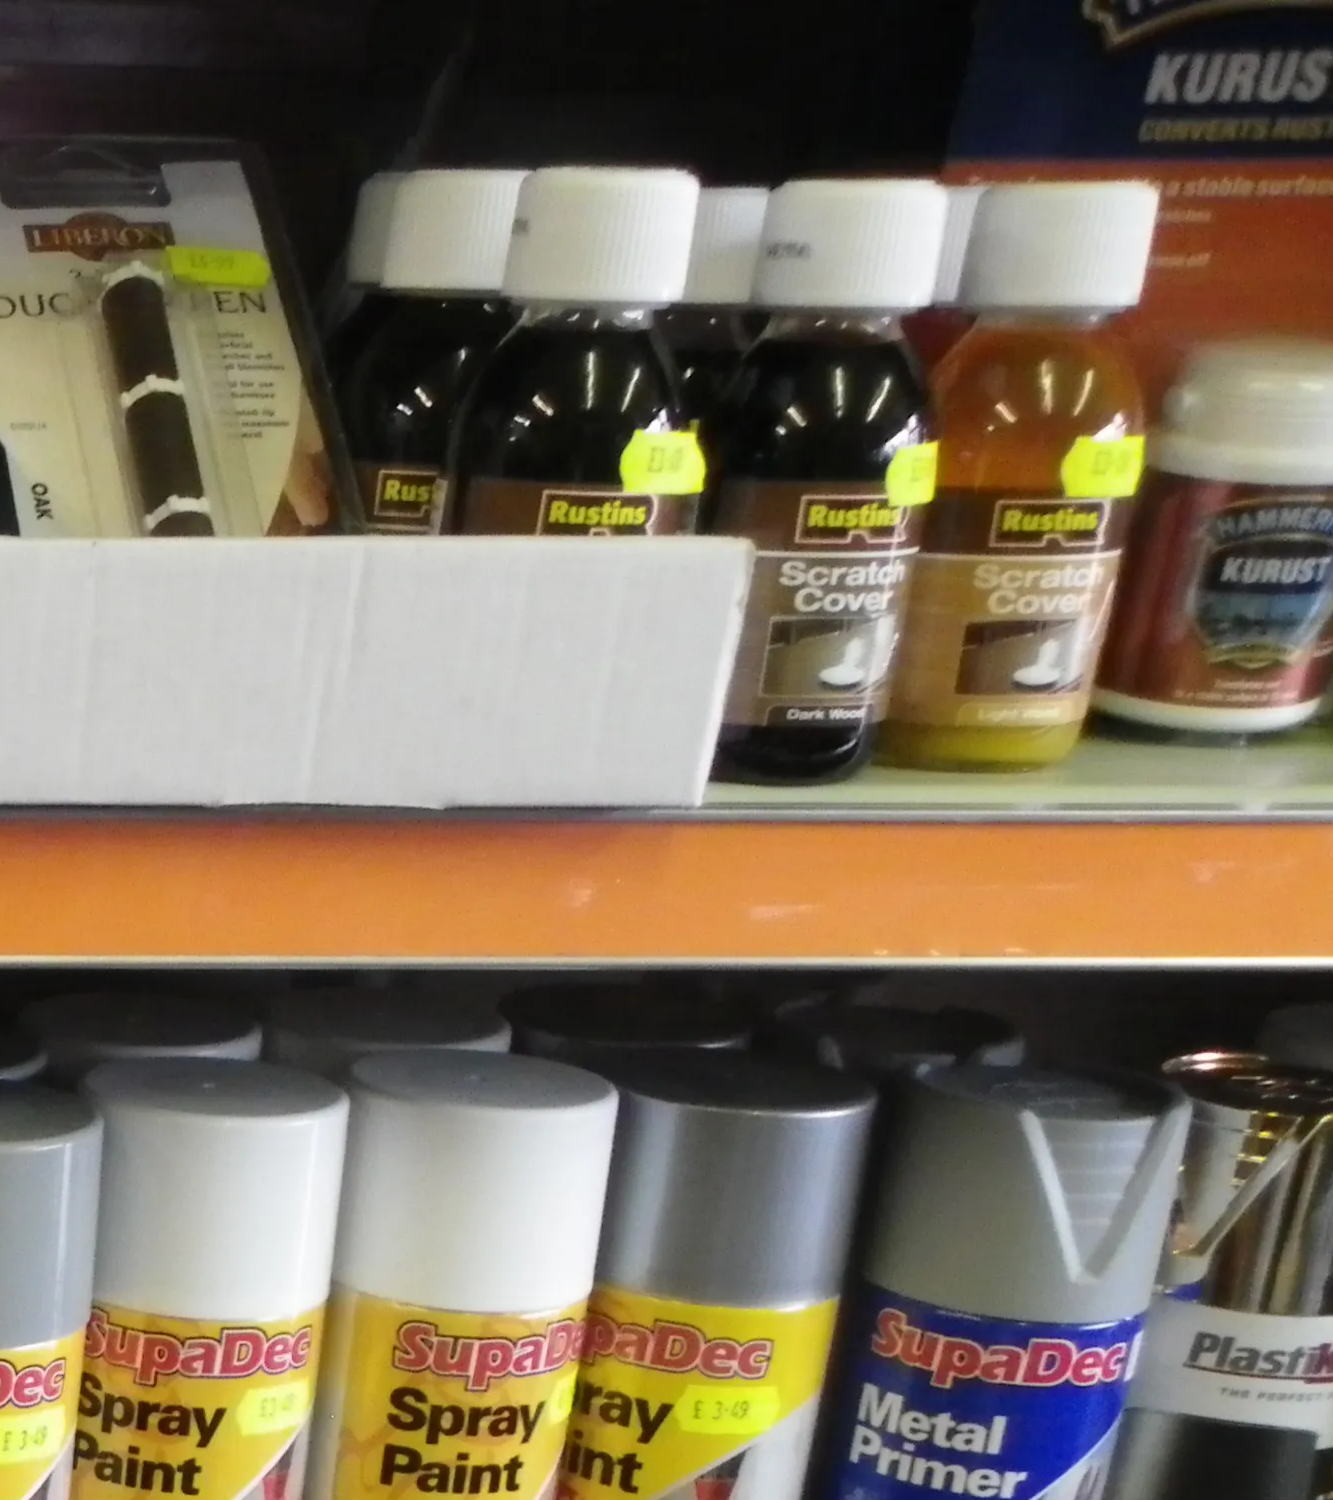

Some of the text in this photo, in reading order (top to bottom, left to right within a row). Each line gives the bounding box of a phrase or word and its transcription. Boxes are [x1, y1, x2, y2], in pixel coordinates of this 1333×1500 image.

[31, 227, 167, 248] LIBERON
[548, 499, 647, 526] Rustins
[808, 502, 902, 528] Rustins
[1002, 508, 1098, 532] Rustins
[778, 557, 906, 588] Scratch
[973, 563, 1104, 590] Scratch
[1221, 556, 1331, 584] KURUST
[794, 588, 894, 613] Cover
[987, 590, 1092, 615] Cover
[871, 1307, 1127, 1389] SupaDec
[78, 1370, 227, 1449] Spray
[387, 1386, 547, 1445] Spray
[857, 1382, 1008, 1455] Metal
[73, 1430, 202, 1496] Paint
[379, 1443, 524, 1495] Paint
[849, 1425, 1028, 1500] Primer
